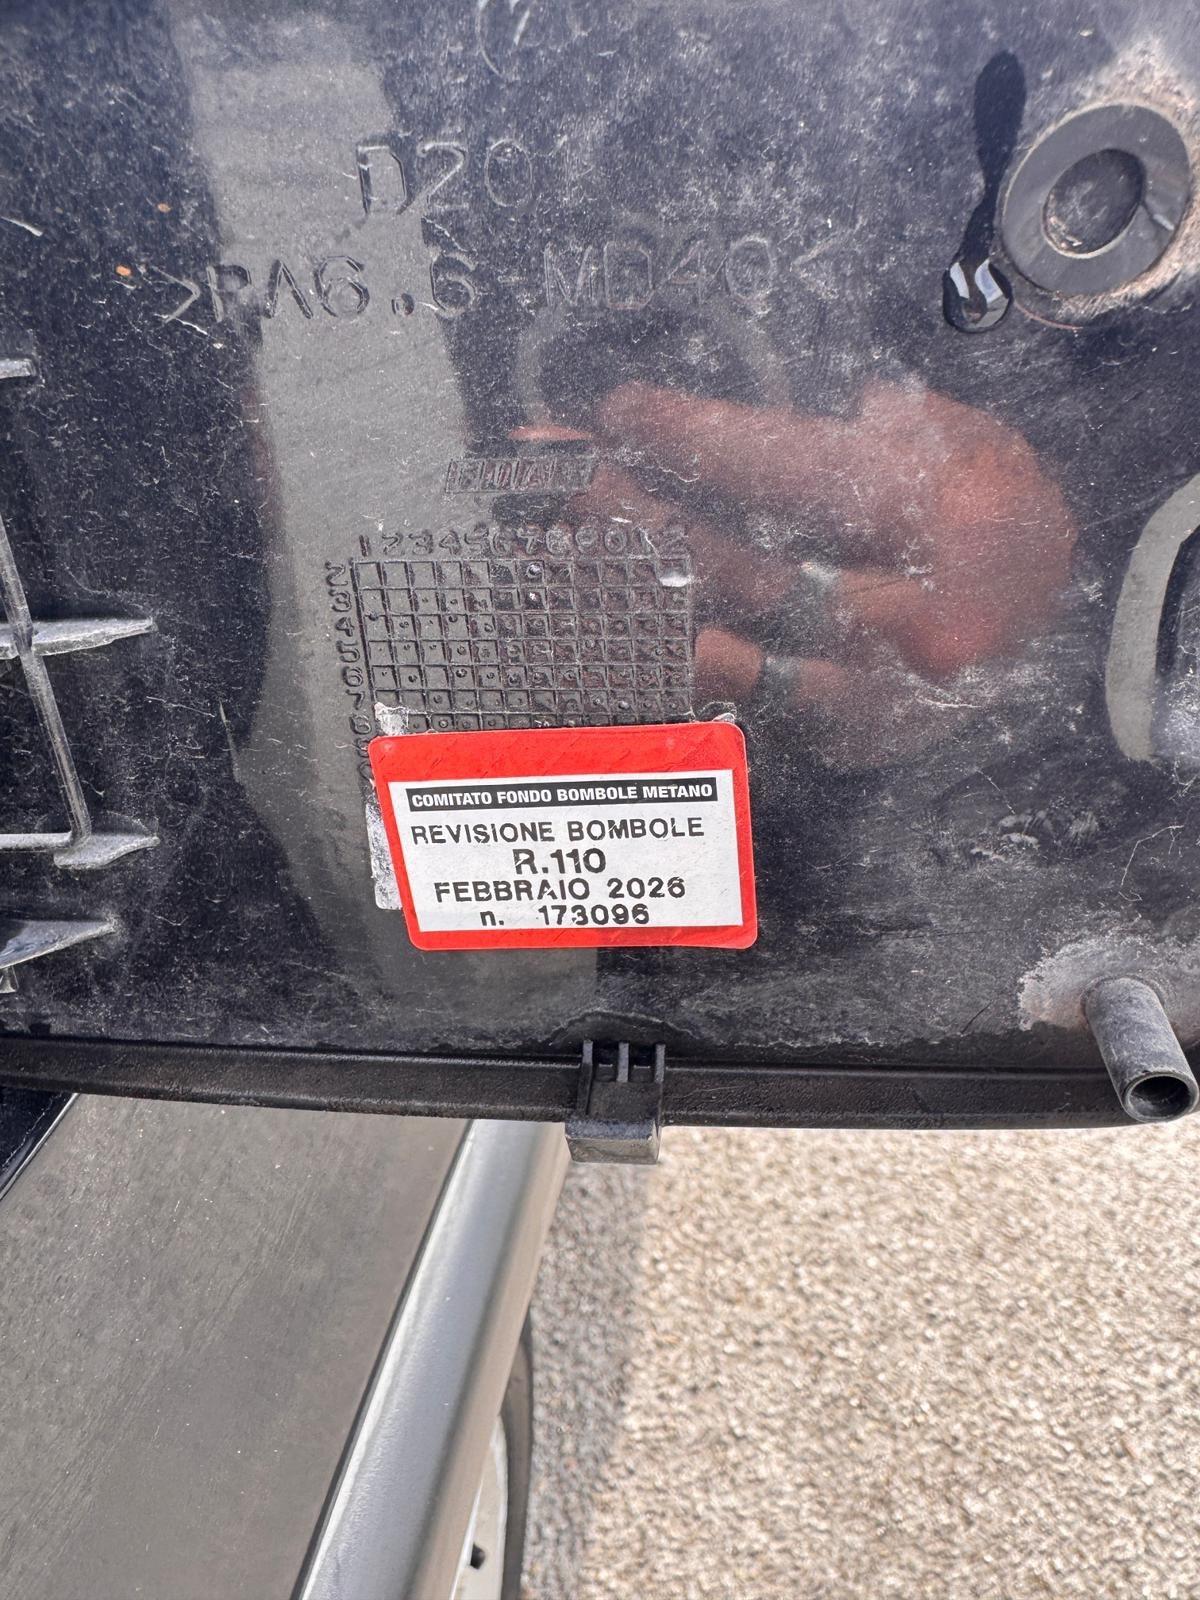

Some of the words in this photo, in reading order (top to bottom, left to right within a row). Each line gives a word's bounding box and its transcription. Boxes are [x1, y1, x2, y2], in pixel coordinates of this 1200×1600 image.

[412, 791, 492, 808] COMITATO
[498, 789, 552, 804] FONDO
[557, 786, 637, 802] BOMBOLE
[642, 783, 713, 799] METANO
[411, 821, 555, 845] REVISIONE
[568, 817, 705, 842] BOMBOLE
[512, 848, 607, 875] R.110
[434, 878, 591, 903] FEBBRAIO
[606, 876, 686, 899] 2026
[480, 908, 505, 927] n.
[538, 904, 650, 926] 173096
